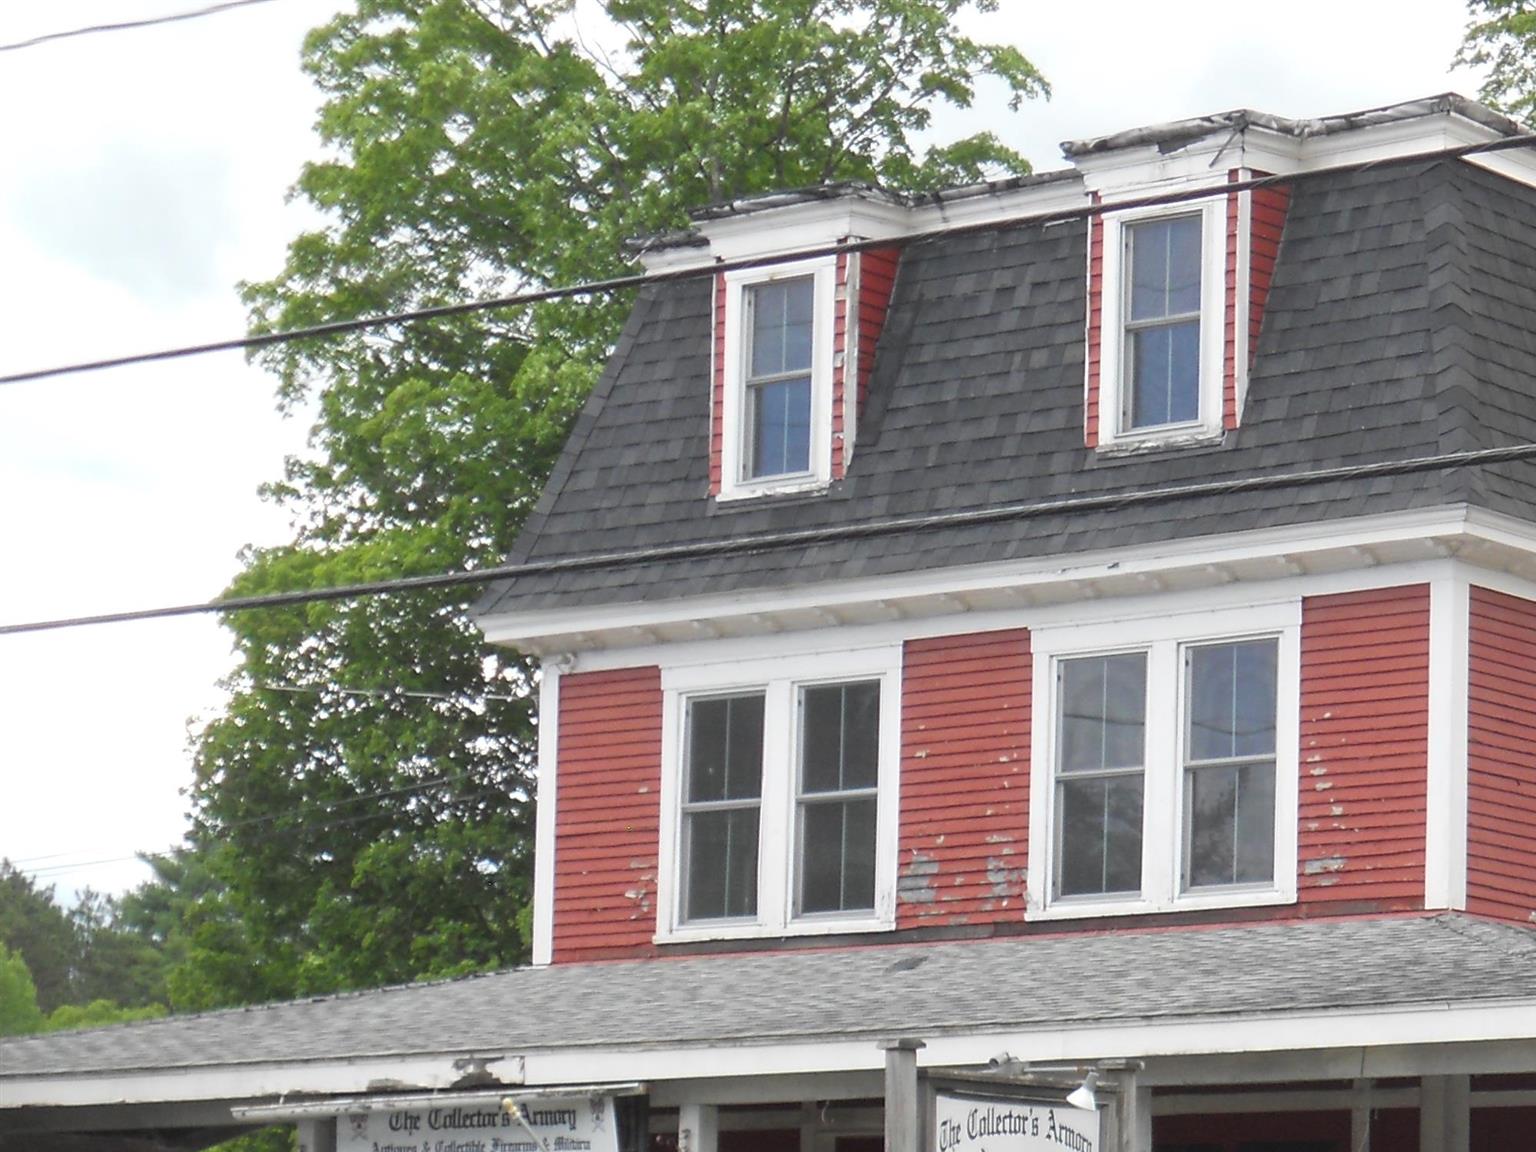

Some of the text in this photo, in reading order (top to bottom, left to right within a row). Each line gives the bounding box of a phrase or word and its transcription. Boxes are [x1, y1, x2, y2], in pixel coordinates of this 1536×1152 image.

[388, 1103, 576, 1136] The Collector's Armory
[967, 1103, 1039, 1140] Collector's
